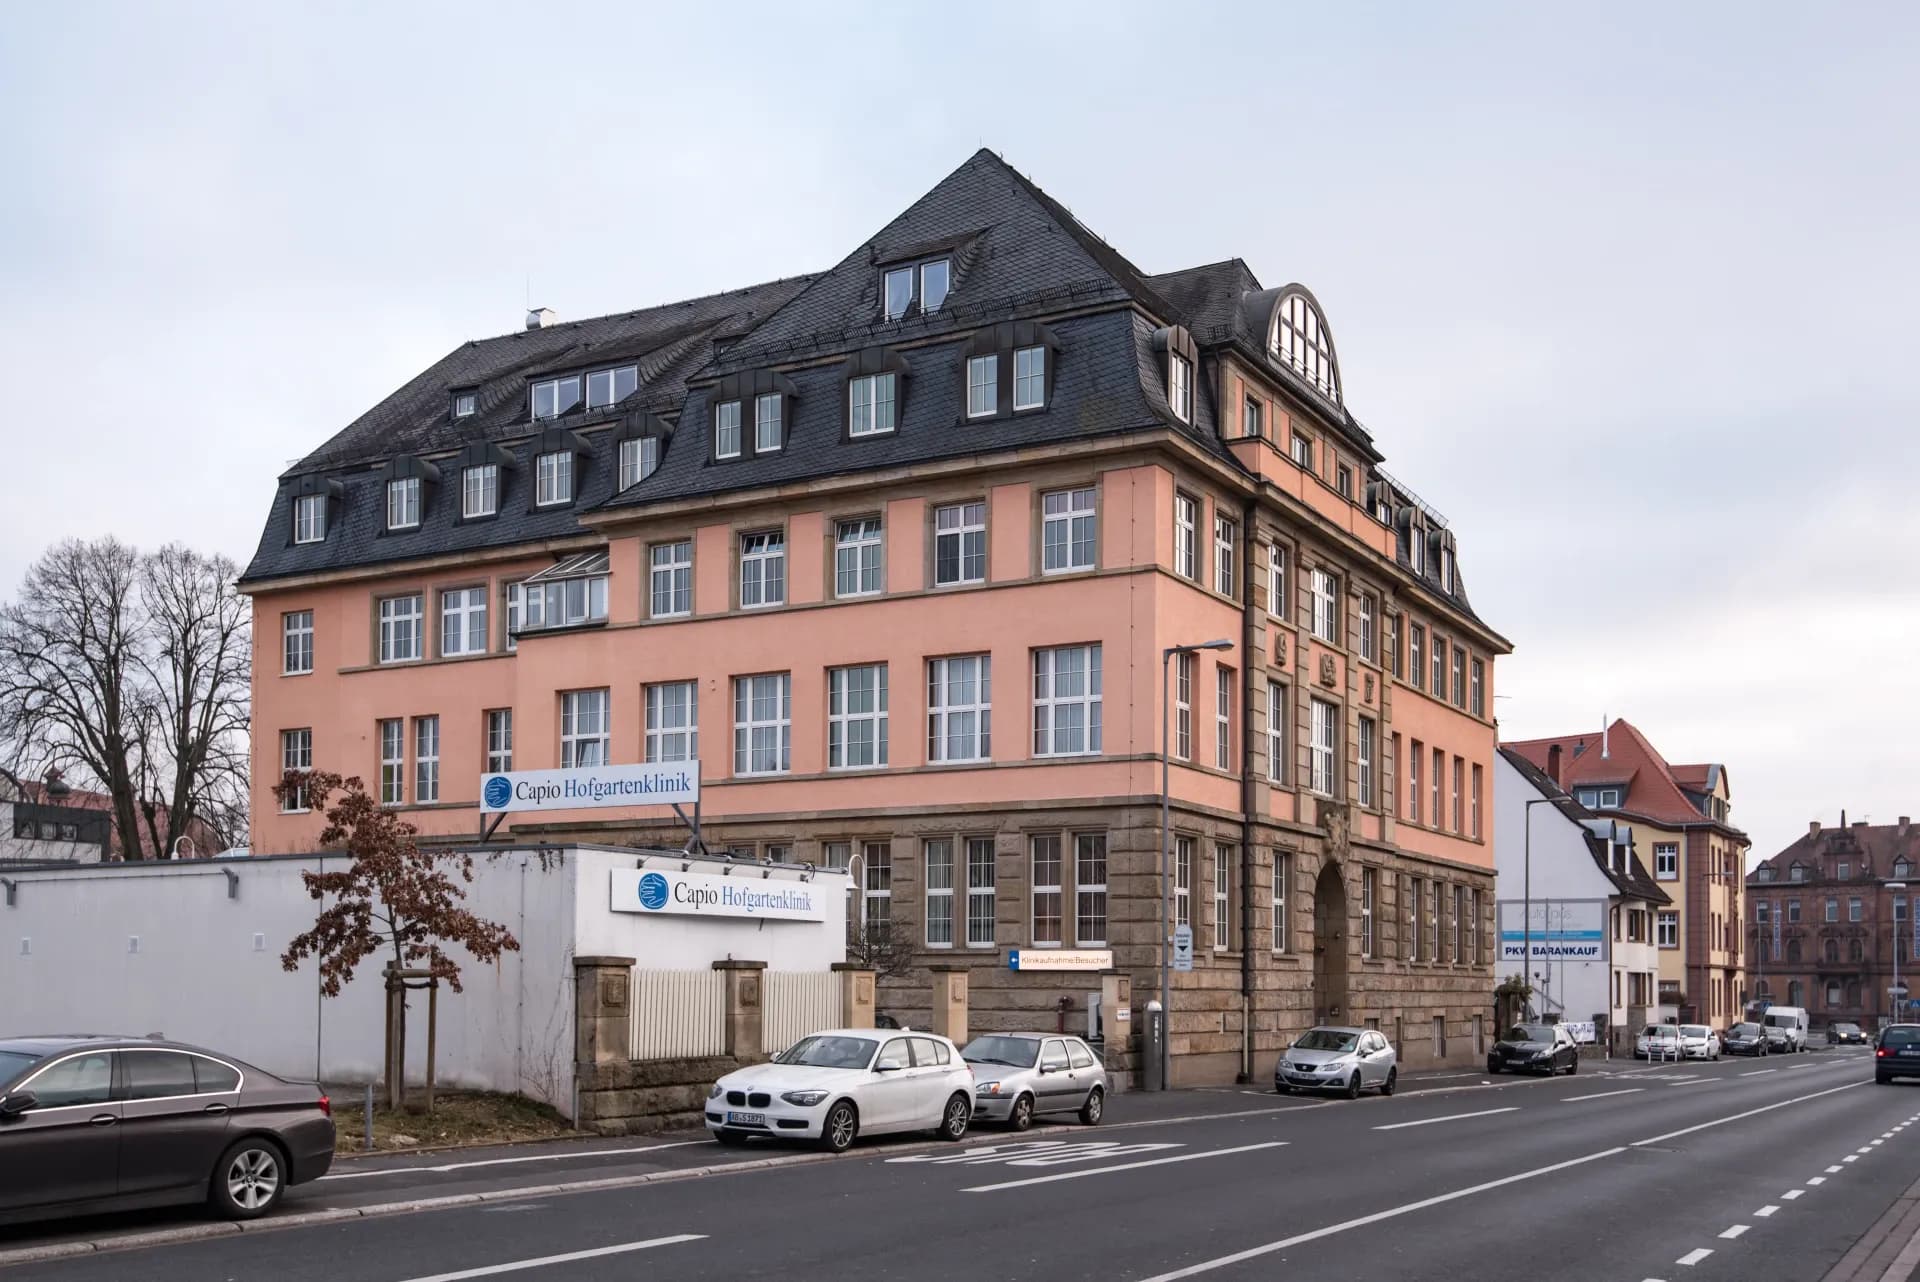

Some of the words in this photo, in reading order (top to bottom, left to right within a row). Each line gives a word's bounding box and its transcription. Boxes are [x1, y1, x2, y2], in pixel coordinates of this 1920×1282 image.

[516, 781, 561, 805] Capio
[564, 772, 691, 801] Hofgartenklinik
[674, 882, 718, 910] Capio
[722, 886, 812, 912] Hofgartenklinik
[1532, 946, 1599, 956] BARANKAUF
[884, 1141, 1188, 1166] BUS
